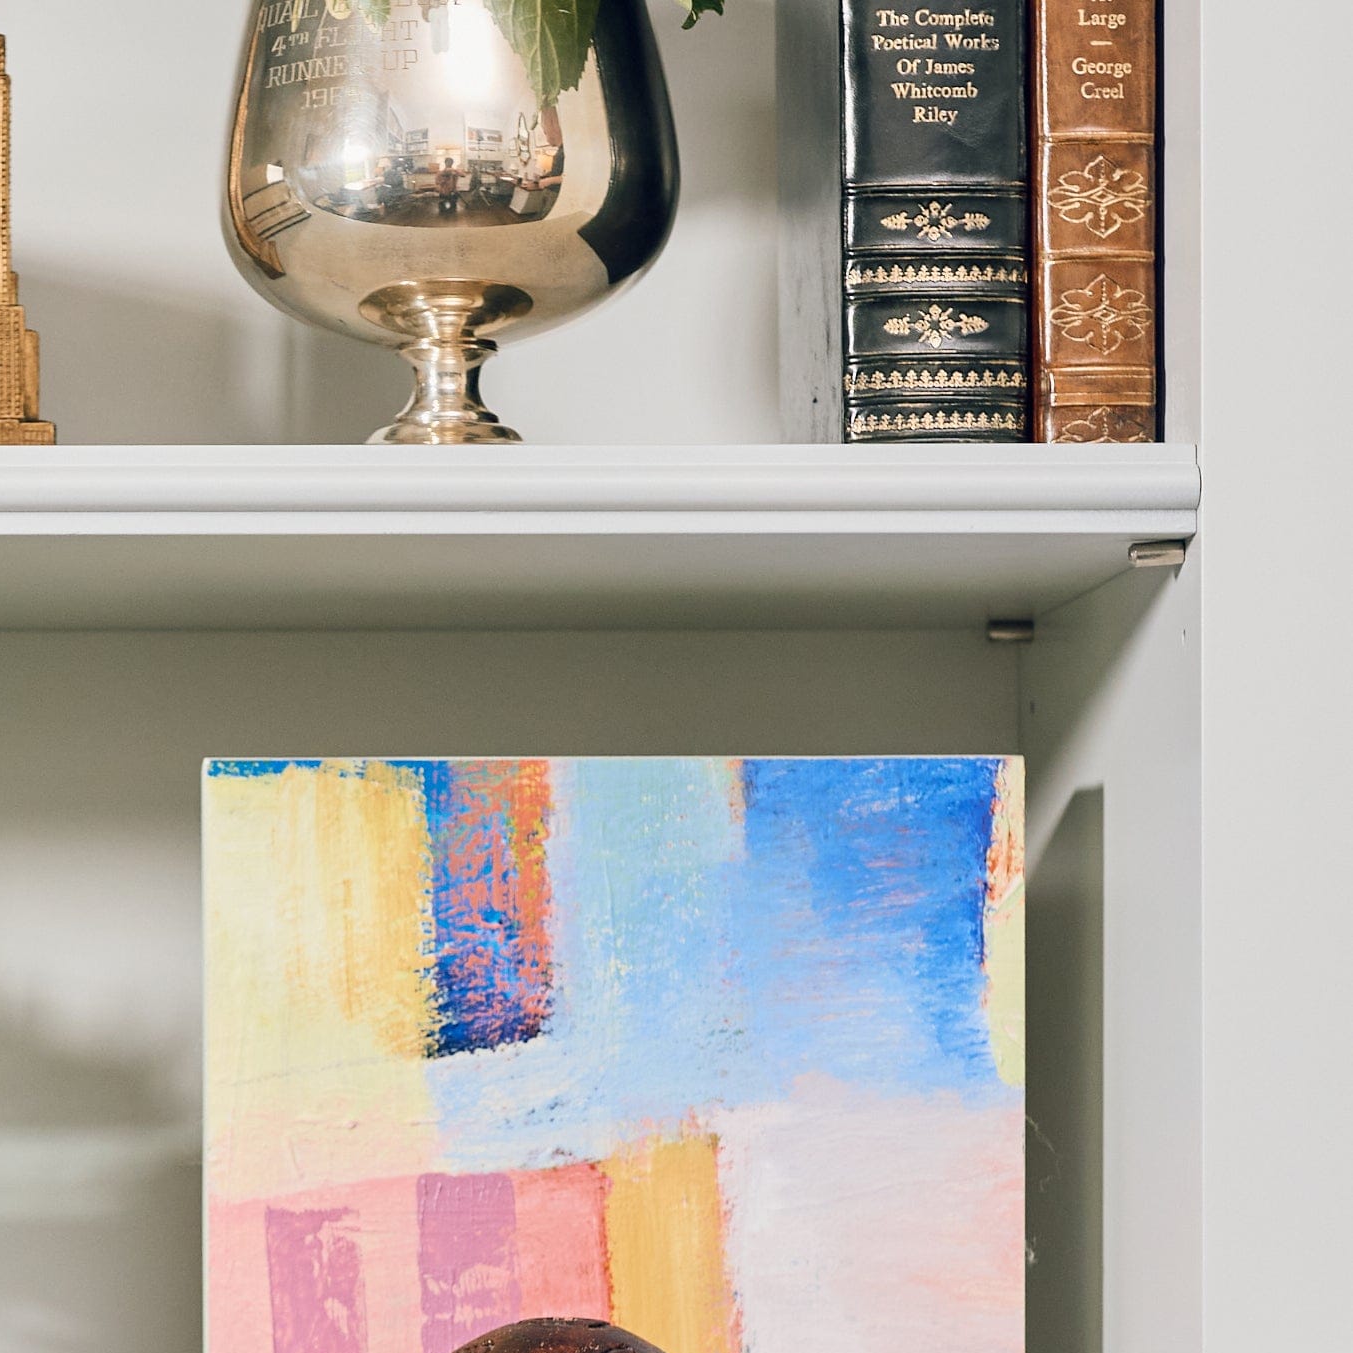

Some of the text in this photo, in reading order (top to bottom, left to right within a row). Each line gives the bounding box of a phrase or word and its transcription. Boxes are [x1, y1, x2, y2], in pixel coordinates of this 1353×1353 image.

[256, 0, 319, 33] QUAL
[876, 9, 995, 29] The Complete
[1077, 8, 1127, 29] Large
[871, 34, 1000, 51] Poetical Works
[897, 58, 975, 75] Of James
[1072, 57, 1133, 78] George
[891, 82, 979, 99] Whitcomb
[1080, 81, 1125, 99] Creel
[912, 106, 958, 126] Riley
